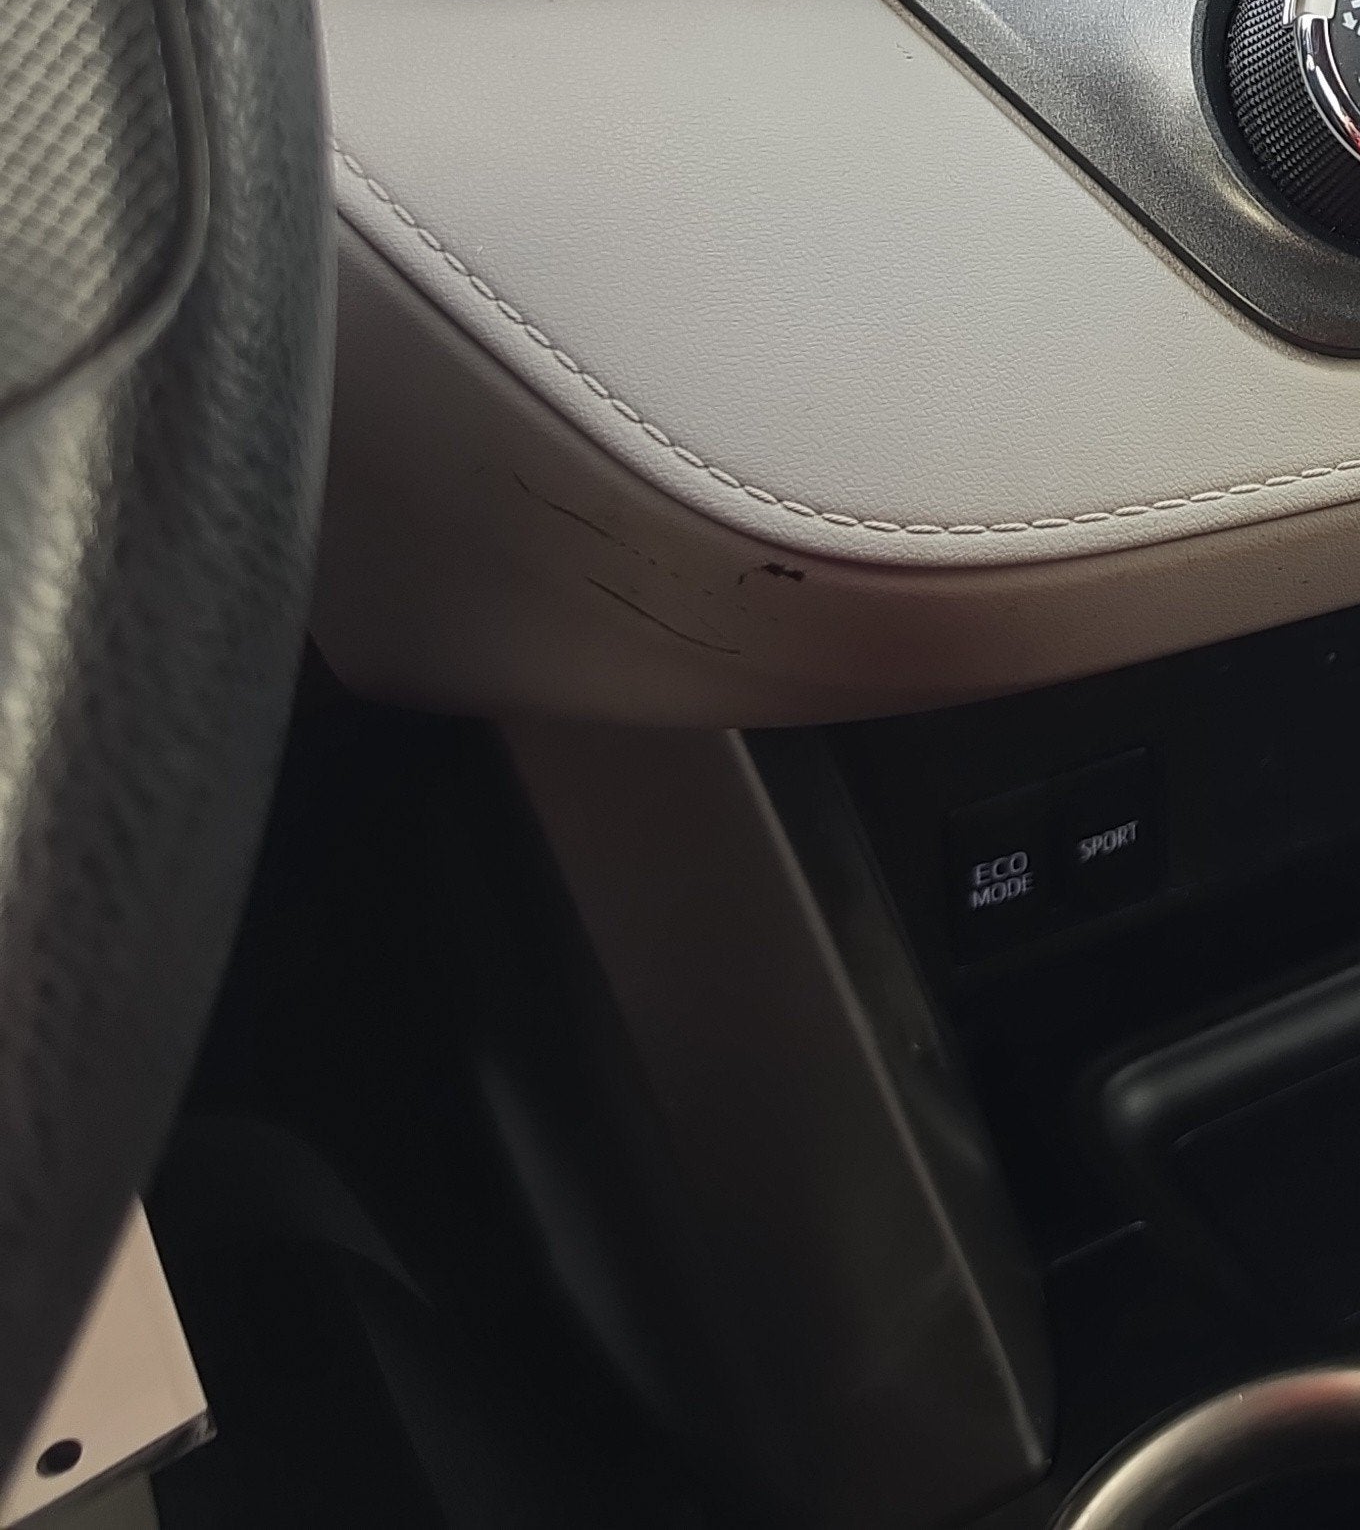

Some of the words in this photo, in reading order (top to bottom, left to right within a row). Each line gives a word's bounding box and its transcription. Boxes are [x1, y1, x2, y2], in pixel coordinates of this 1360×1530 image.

[1077, 820, 1139, 863] SPORT
[974, 851, 1028, 886] ECO
[970, 871, 1033, 909] MODE
